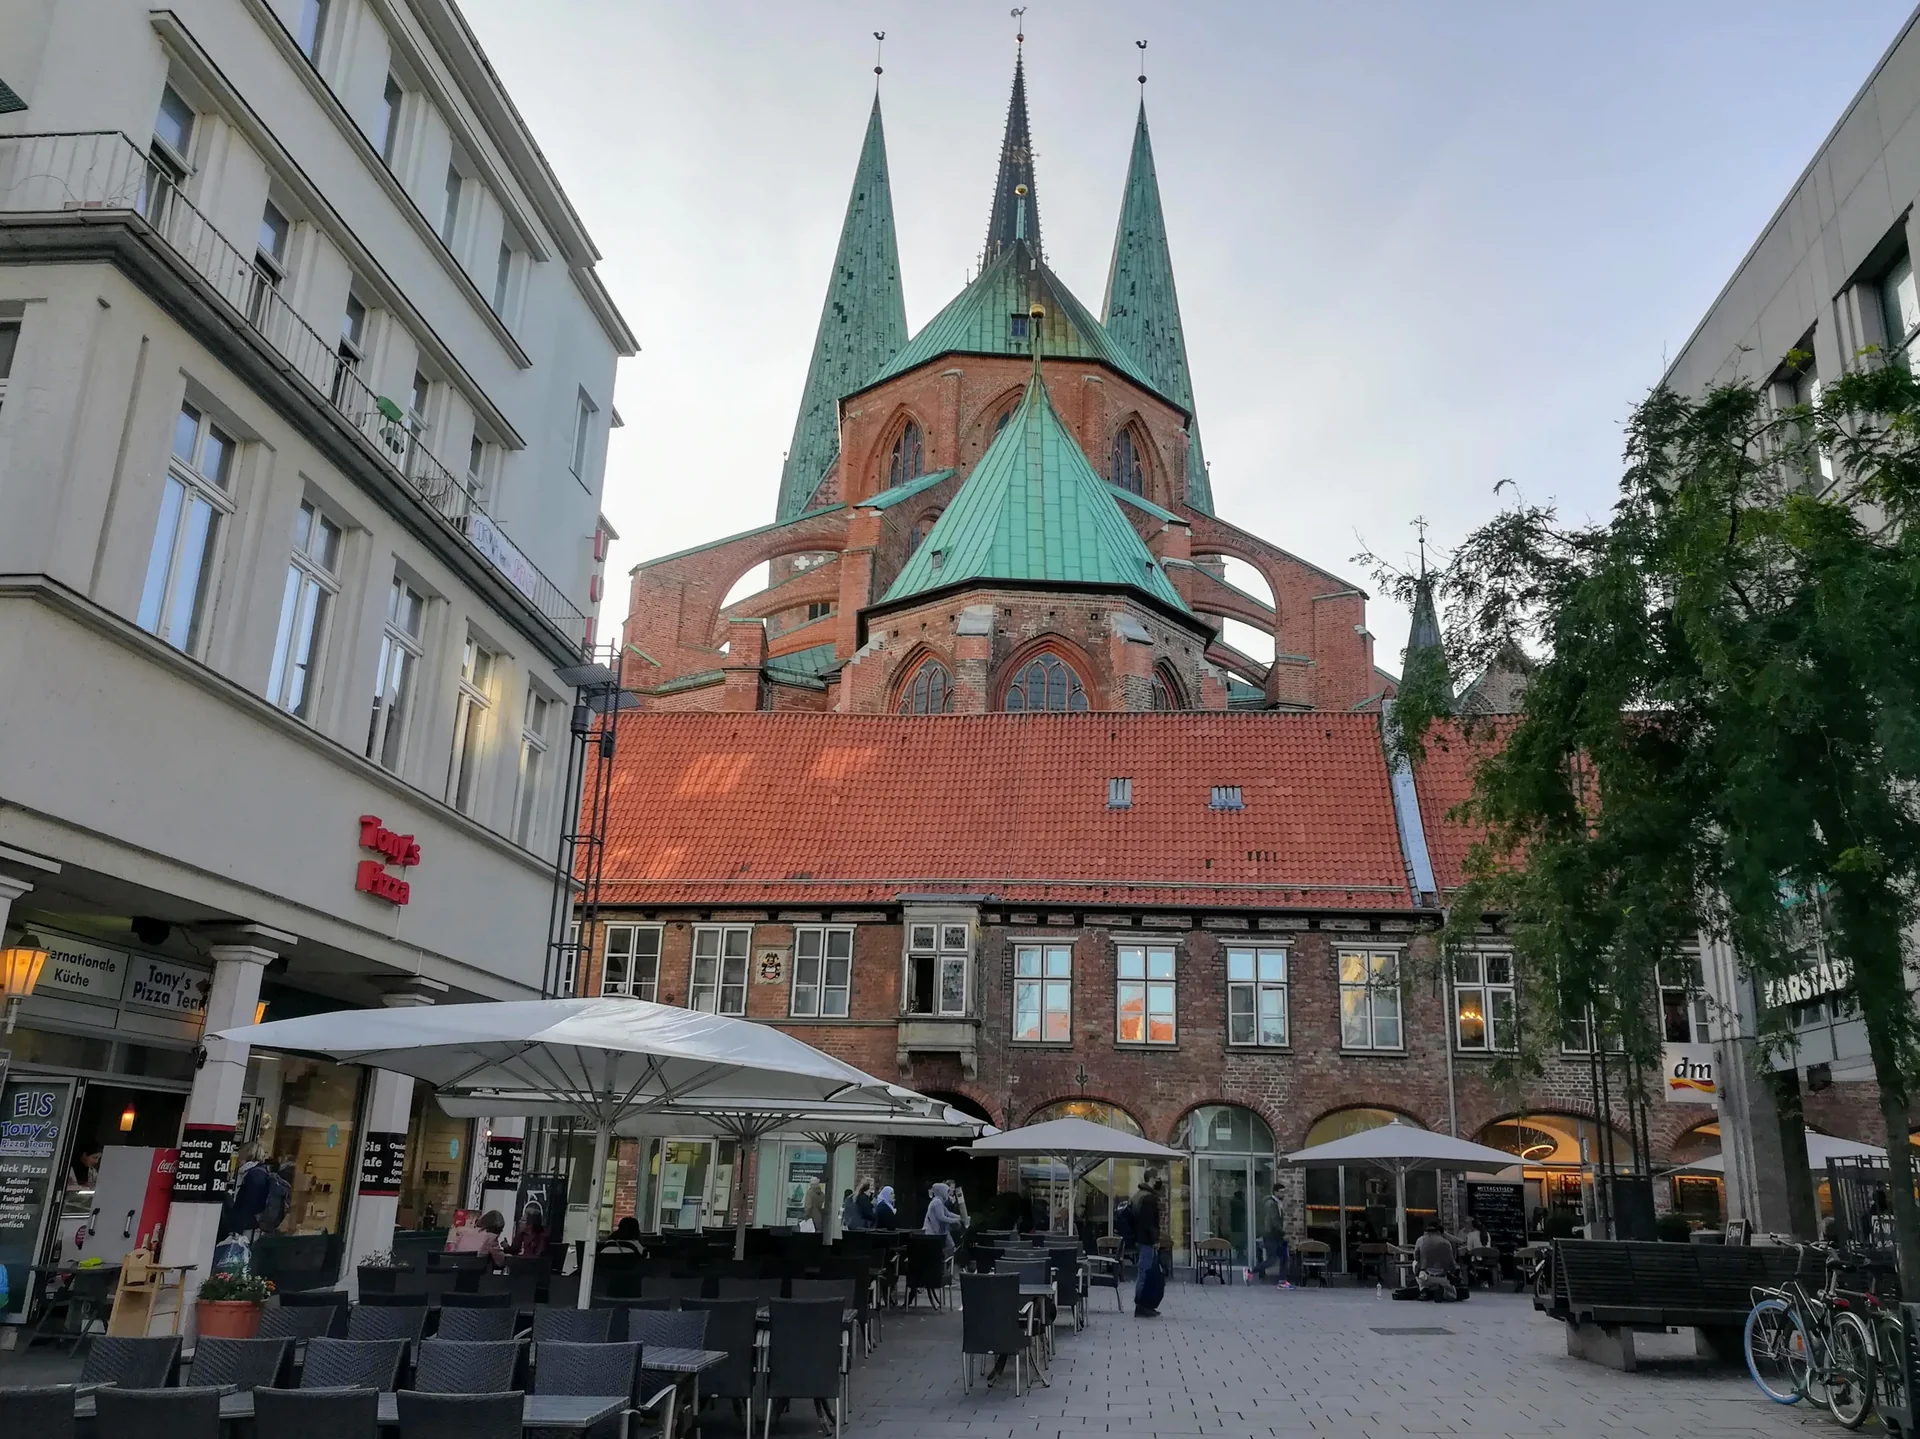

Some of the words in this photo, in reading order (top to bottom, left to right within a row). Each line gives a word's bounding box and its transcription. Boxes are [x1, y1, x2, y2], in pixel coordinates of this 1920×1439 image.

[359, 815, 421, 866] Tony's
[355, 860, 410, 906] Pizza
[54, 968, 90, 987] Küche
[149, 965, 191, 991] Tony's
[133, 981, 170, 1005] Pizza
[1674, 1057, 1712, 1079] dm
[14, 1092, 55, 1117] EIS
[1, 1121, 58, 1139] Tony's
[22, 1164, 47, 1174] Pizza
[178, 1161, 200, 1169] Salat
[6, 1177, 30, 1185] Salami
[176, 1172, 200, 1181] Gyros
[3, 1195, 25, 1203] Funghi
